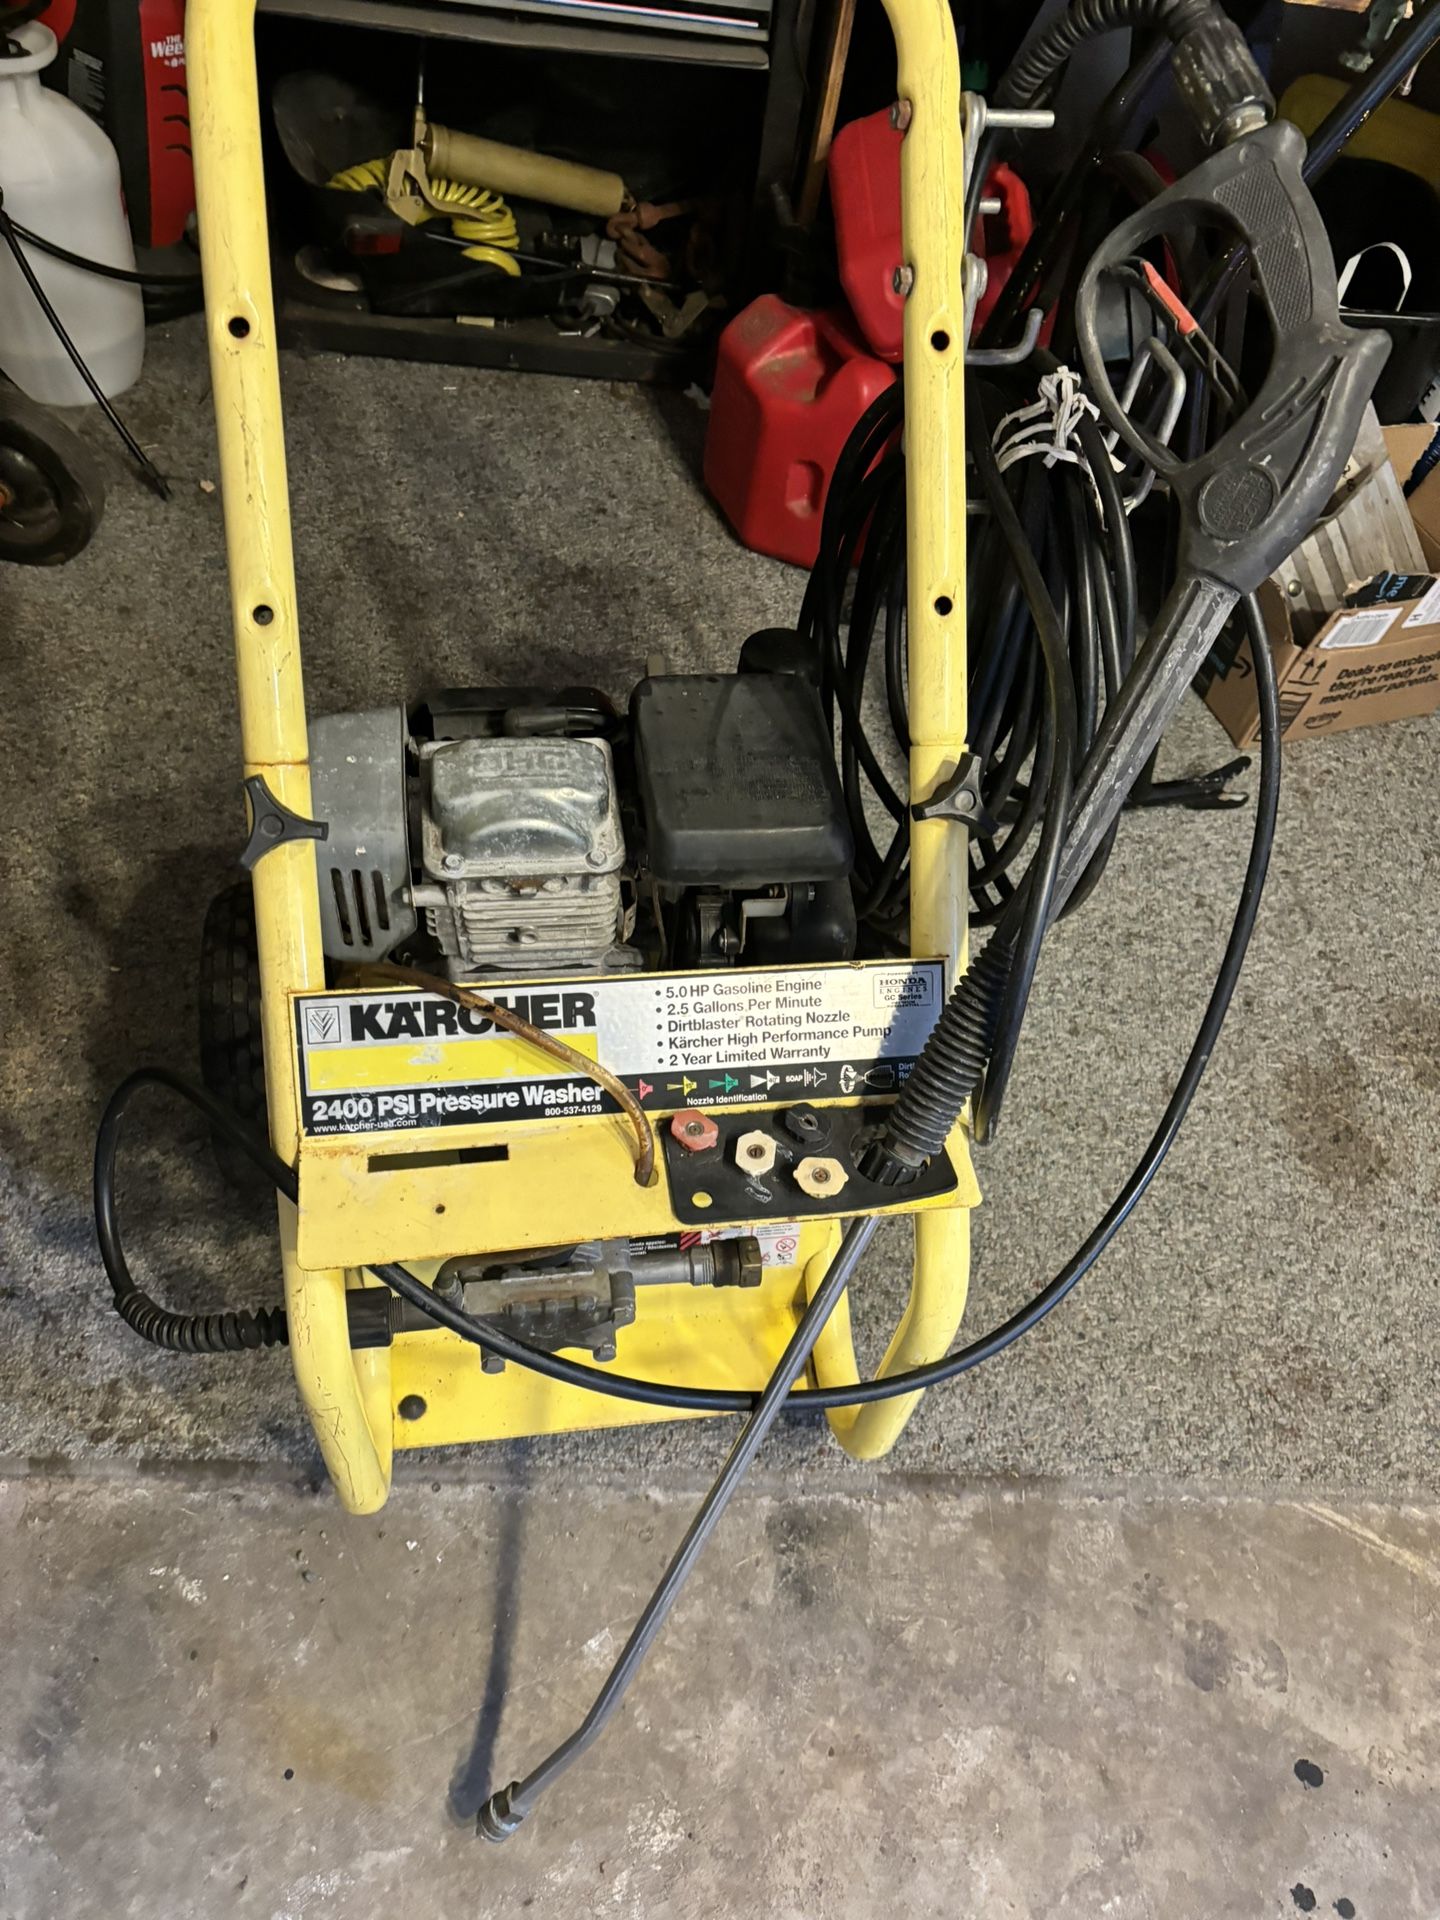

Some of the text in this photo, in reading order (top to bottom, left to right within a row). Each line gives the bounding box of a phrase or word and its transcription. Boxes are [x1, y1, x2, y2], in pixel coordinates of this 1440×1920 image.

[166, 34, 181, 44] THE
[151, 42, 185, 58] Wee
[1329, 664, 1432, 692] they're ready to
[1337, 664, 1375, 680] Deals
[1375, 662, 1392, 673] so
[665, 979, 823, 999] 5.0 HP Gasoline Engine
[880, 976, 926, 985] HONDA
[880, 986, 927, 994] ENGINES
[884, 992, 922, 1001] GC Series
[667, 995, 823, 1016] 2.5 Gallons Per Minute
[349, 992, 597, 1041] KÄRCHER
[667, 1009, 851, 1033] Dirtblaster Rotating Nozzle
[668, 1024, 893, 1050] Kärcher High Performance Pump
[668, 1044, 832, 1067] 2 Year Limited Warranty
[785, 1074, 804, 1083] SOAP
[312, 1082, 604, 1122] 2400 PSI Pressure Washer
[686, 1092, 768, 1107] Nozzle Identification
[544, 1103, 603, 1117] 800-537-4129
[313, 1118, 418, 1134] www.karcher-usa.com
